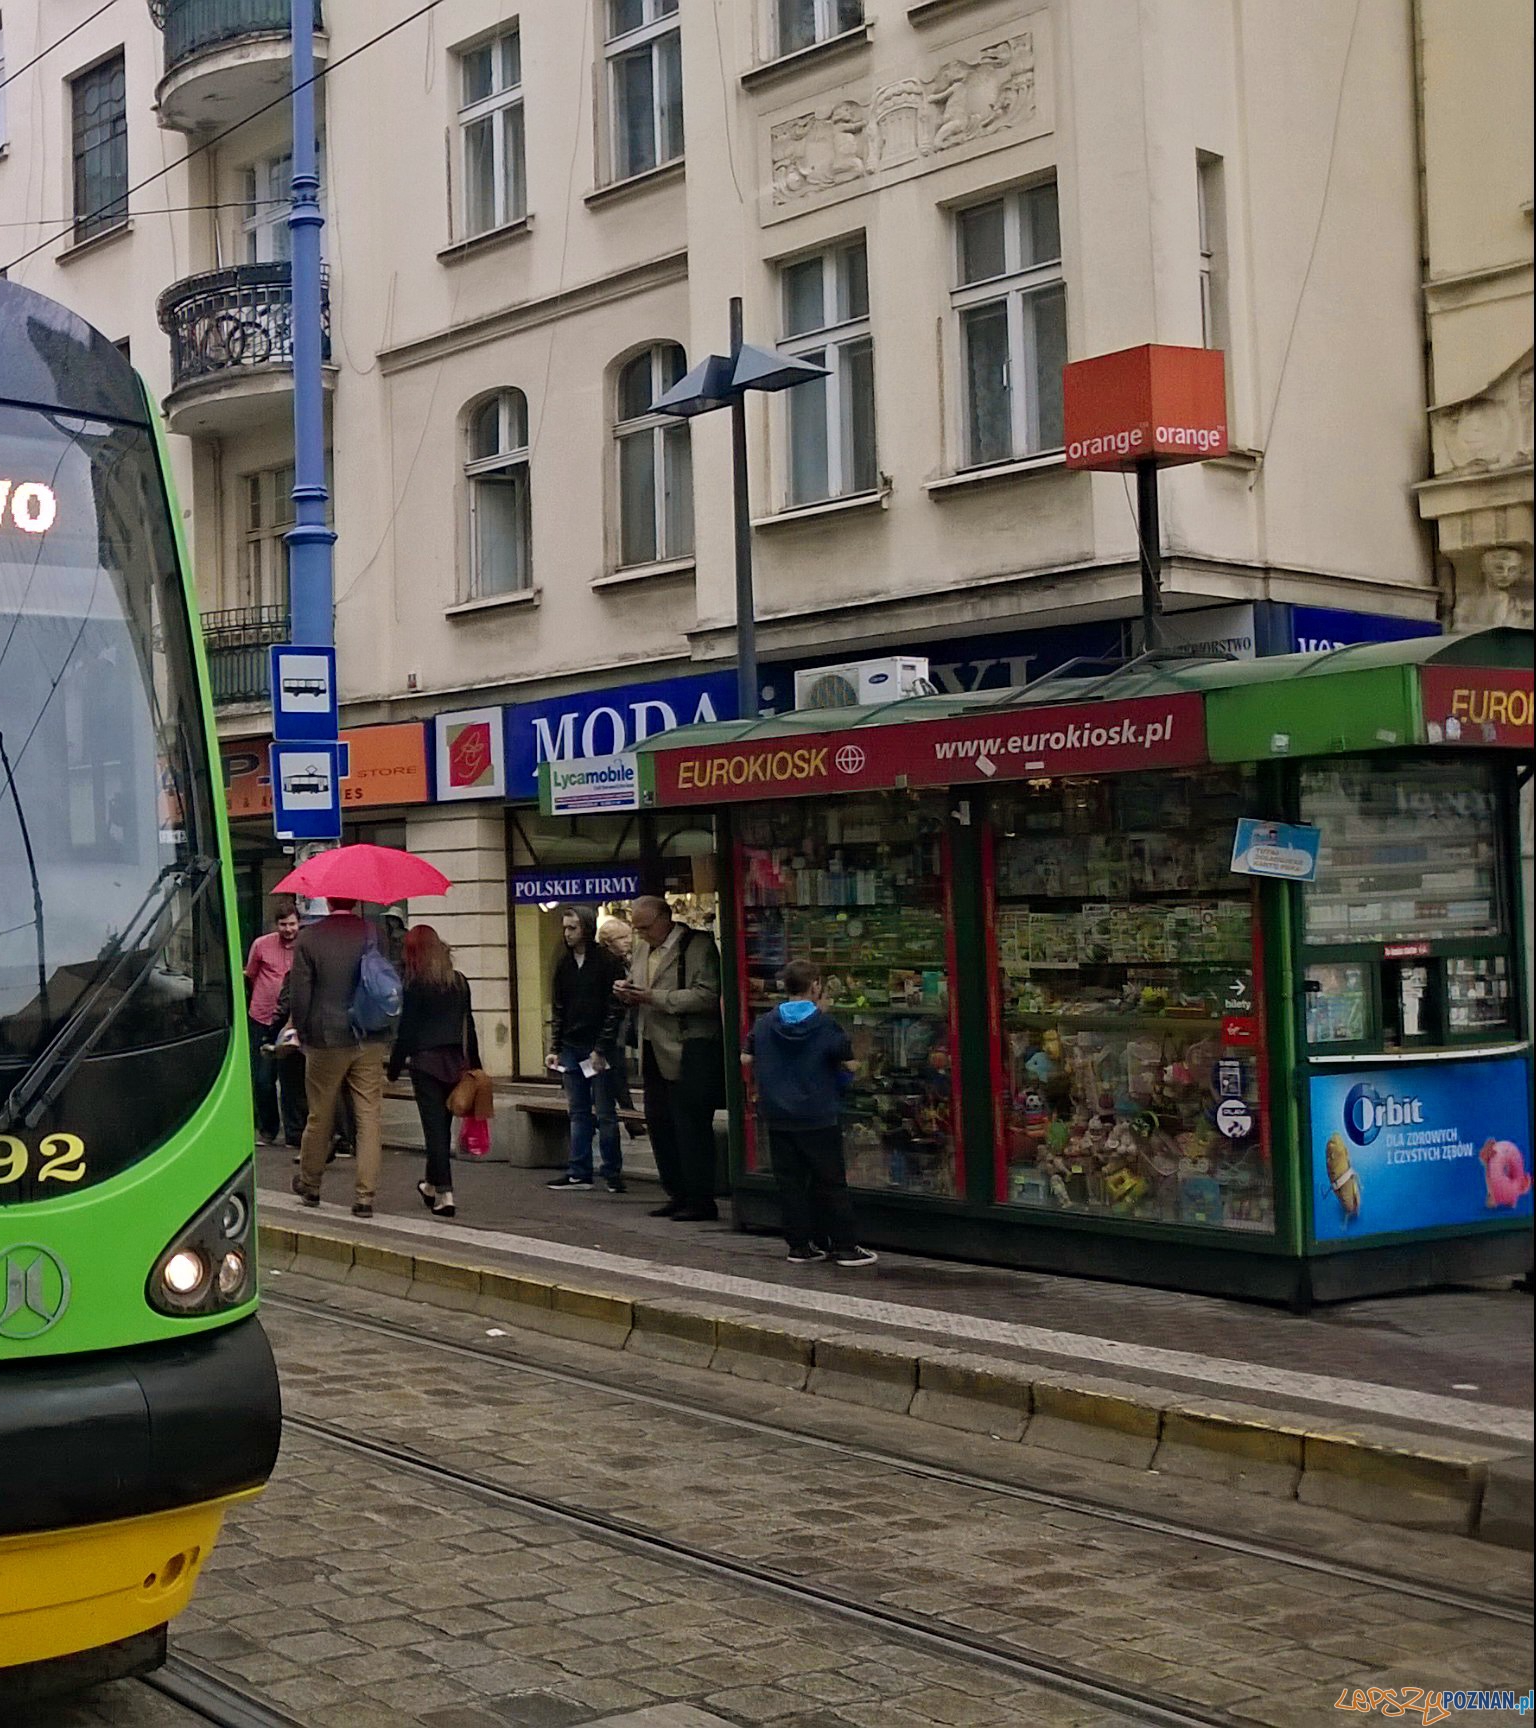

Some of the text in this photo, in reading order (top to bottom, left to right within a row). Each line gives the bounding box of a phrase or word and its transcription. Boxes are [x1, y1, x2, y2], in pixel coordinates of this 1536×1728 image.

[1069, 428, 1143, 459] orange
[1156, 426, 1221, 452] orange
[935, 714, 1174, 760] www.eurokiosk.pl
[357, 766, 417, 778] STORE
[553, 764, 635, 790] Lycamobile
[677, 747, 829, 789] EUROKIOSK
[515, 877, 638, 897] POLSKIE FIRMY
[1225, 1000, 1251, 1010] bilety
[1343, 1082, 1424, 1146] Orbit
[1386, 1133, 1404, 1147] DLA
